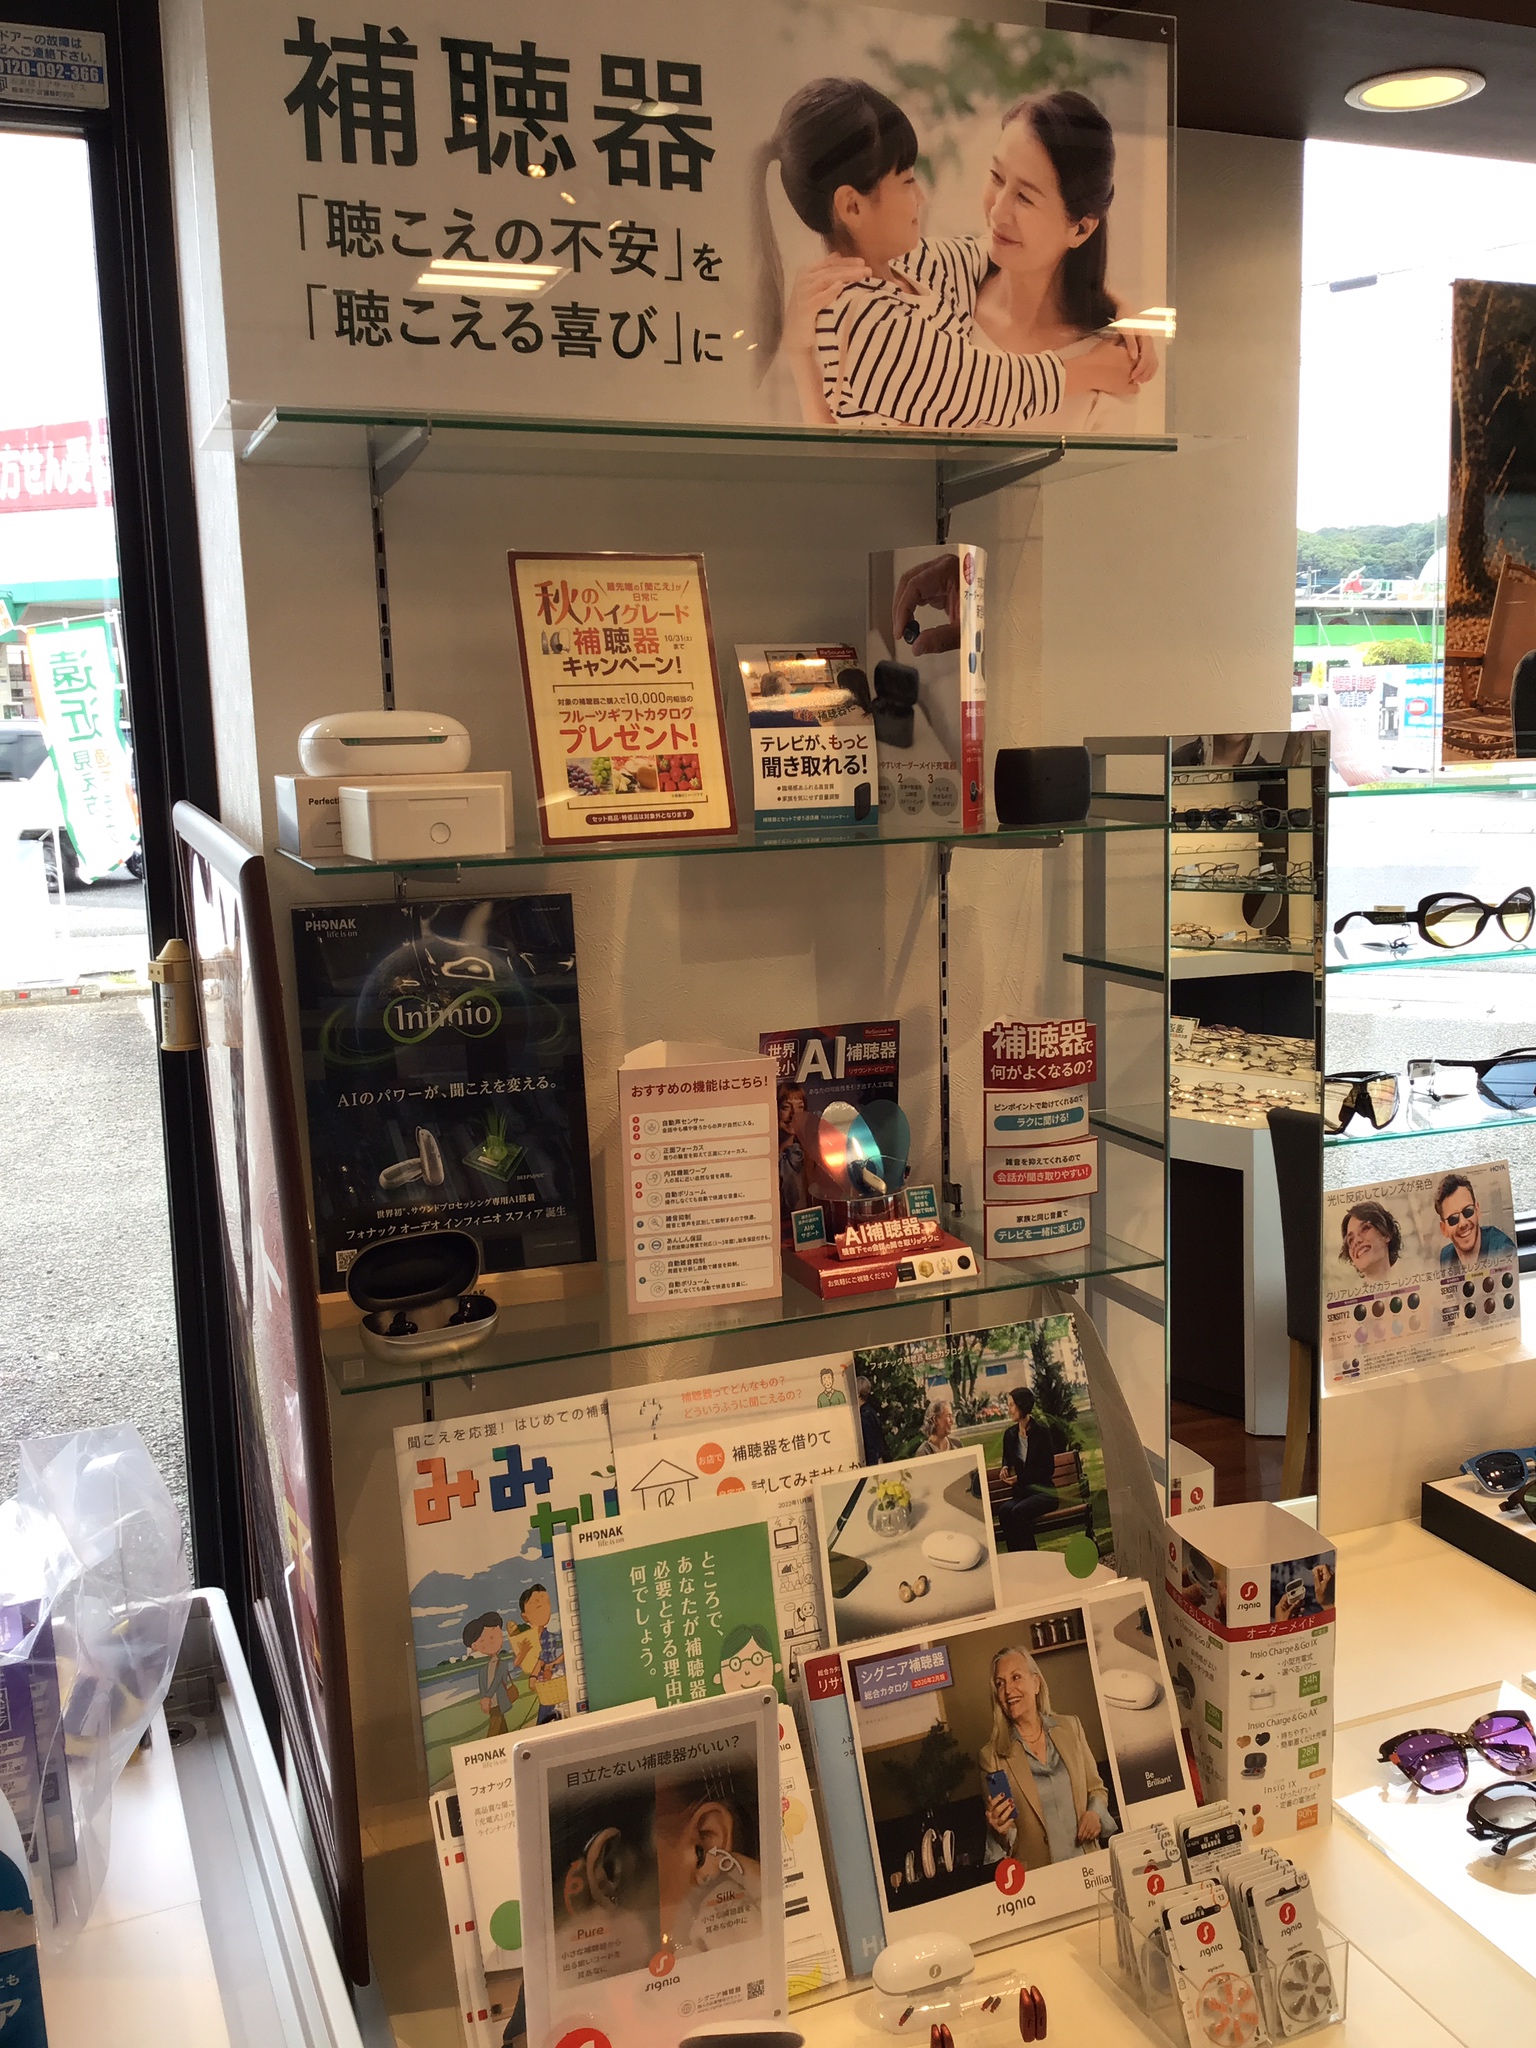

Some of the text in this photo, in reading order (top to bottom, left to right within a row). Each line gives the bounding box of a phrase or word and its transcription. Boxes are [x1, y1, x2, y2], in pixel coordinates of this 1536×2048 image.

[283, 16, 716, 192] 補聴器
[297, 193, 723, 282] 「聴こえの不安」を
[306, 283, 723, 365] 「聴こえる喜び」に
[534, 580, 599, 625] 秋の
[583, 604, 690, 625] ハイグレード
[573, 627, 660, 655] 補聴器
[562, 656, 682, 677] キャンペーン!
[559, 706, 694, 724] フルーツギフトカタログ
[559, 722, 699, 754] プレゼント!
[760, 733, 868, 752] テレビが、もっと
[762, 754, 867, 779] 聞き取れる!
[897, 773, 903, 783] 2
[927, 774, 934, 784] 3
[305, 918, 357, 932] PHONAK
[768, 1042, 796, 1058] 世界
[992, 1019, 1093, 1060] 補聴器で
[794, 1036, 897, 1083] AI 補聴器
[990, 1060, 1093, 1081] 何がよくなるの?
[337, 1076, 556, 1108] AIのパワーが、聞こえを変える。
[631, 1075, 768, 1098] おすすめの機能はこちら!
[1016, 1113, 1069, 1127] ラクに聞ける!
[663, 1145, 704, 1154] 正面フォーカス
[1005, 1154, 1081, 1166] 雑音を抑えてくれるので
[997, 1166, 1089, 1183] 会話が聞き取りやすい!
[665, 1189, 706, 1198] 自動ボリューム
[1327, 1178, 1433, 1207] 光に反応してレンズが発色
[346, 1207, 567, 1241] フォナック オーデオ インフィニオ スフィア 誕生
[1016, 1209, 1069, 1223] 家族と同じ音量で
[667, 1235, 702, 1244] あんしん保証
[846, 1217, 921, 1246] AI補聴器
[669, 1279, 710, 1288] 自動ボリューム
[681, 1376, 785, 1403] 補聴器ってどんなもの?
[685, 1389, 802, 1419] どういうふうに聞こえるの?
[407, 1423, 504, 1450] 聞こえを応援!
[732, 1430, 831, 1462] 補聴器を借りて
[579, 1525, 624, 1544] PHONAK
[702, 1551, 724, 1636] ところで、
[1237, 1602, 1261, 1611] signia
[629, 1565, 657, 1676] 何でしょう。
[677, 1556, 707, 1698] あなたが補聴器
[1247, 1617, 1316, 1639] オーダーメイド
[653, 1560, 682, 1708] 必要とする理由
[861, 1651, 945, 1685] シグニア補聴器
[864, 1681, 909, 1701] 総合カタログ
[464, 1747, 506, 1766] PHONAK
[566, 1735, 740, 1788] 目立たない補聴器がいい?
[1145, 1771, 1155, 1780] Be
[1082, 1867, 1095, 1877] Be
[716, 1891, 736, 1903] Silk
[996, 1895, 1036, 1917] signia
[577, 1926, 604, 1940] Pure
[1281, 1922, 1303, 1937] signia
[1199, 1943, 1223, 1958] signia
[645, 1975, 681, 1992] signia
